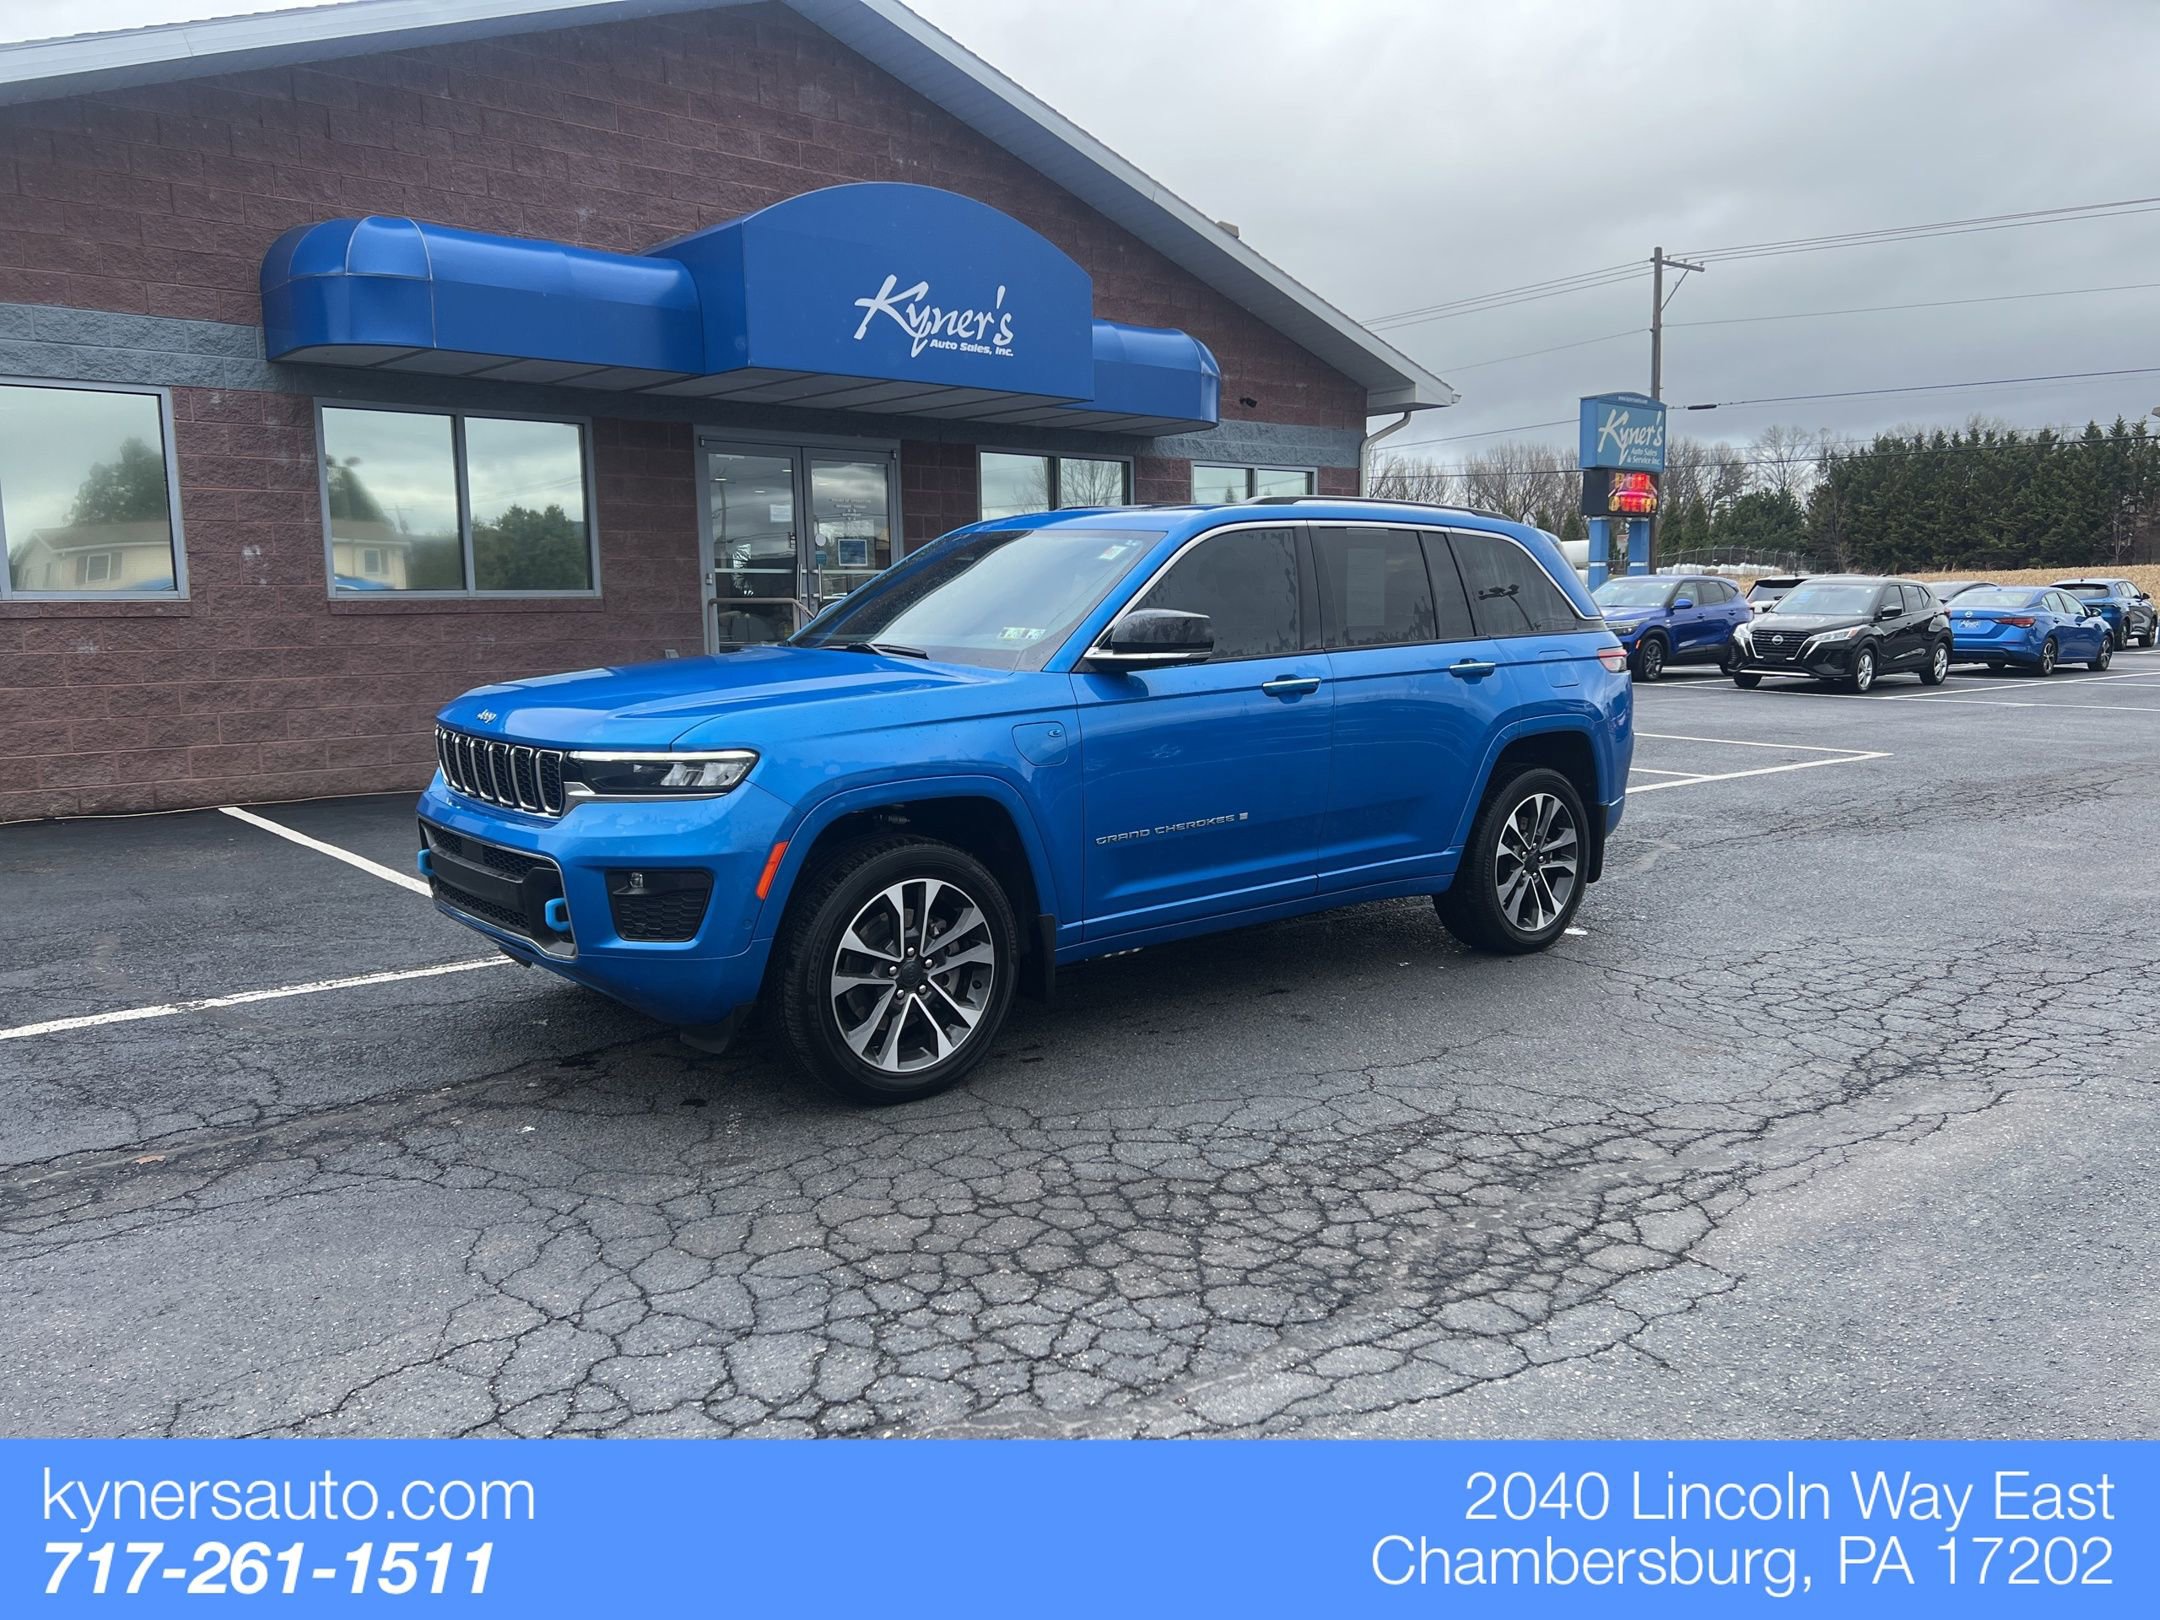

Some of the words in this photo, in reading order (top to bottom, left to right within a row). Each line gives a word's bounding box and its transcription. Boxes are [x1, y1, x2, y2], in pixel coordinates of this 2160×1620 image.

[854, 274, 1013, 358] Kyner's
[930, 338, 958, 350] Auto
[960, 342, 993, 355] Sales,
[995, 347, 1013, 357] Inc.
[1597, 408, 1663, 466] Kyner's
[1631, 447, 1644, 456] Auto
[1095, 828, 1150, 845] GRAND
[1155, 814, 1235, 835] CHEROKEE
